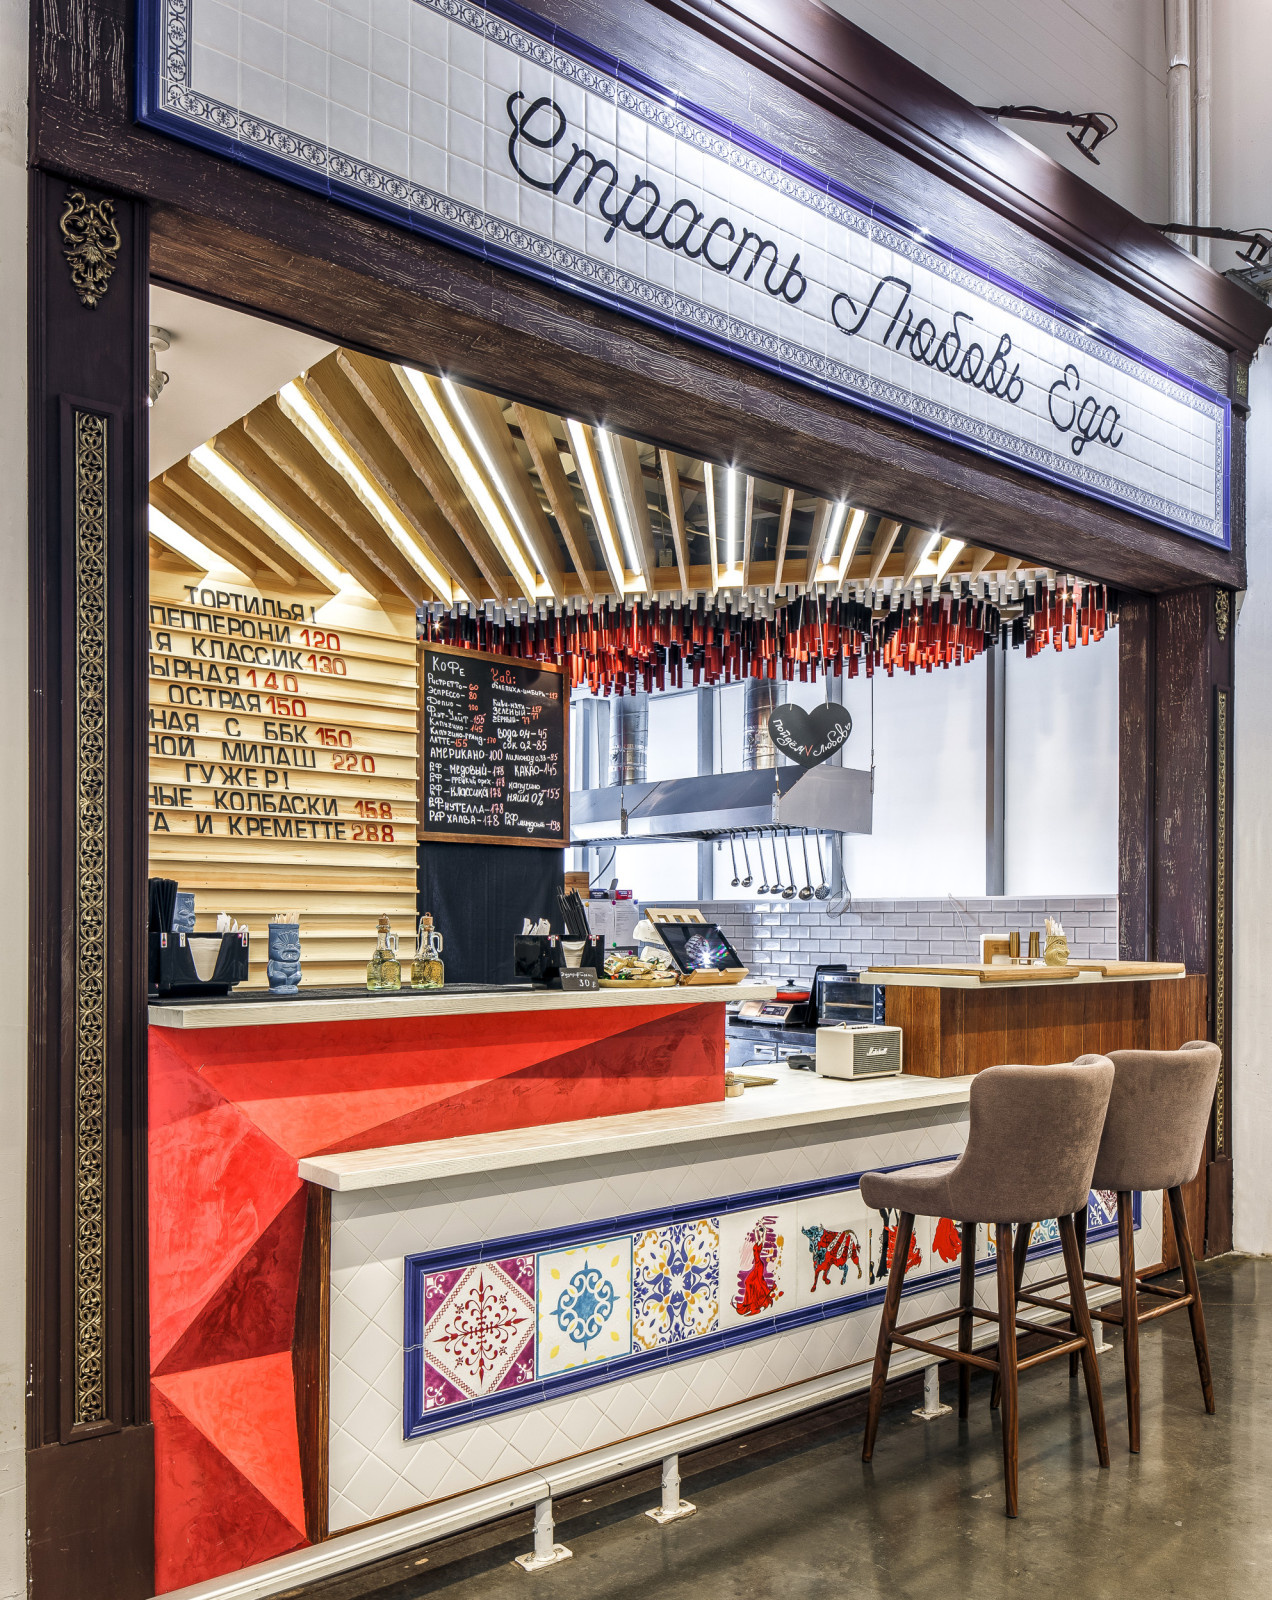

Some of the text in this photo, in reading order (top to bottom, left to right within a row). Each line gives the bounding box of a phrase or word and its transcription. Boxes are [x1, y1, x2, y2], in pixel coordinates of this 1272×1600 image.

[507, 91, 1123, 456] Страсть Любовь Еда
[150, 605, 340, 651] ПЕППЕРОНИ 120
[149, 631, 346, 676] Я КЛАССИК 130
[149, 656, 298, 692] ЫРНАЯ 140
[169, 684, 306, 717] ОСТРАЯ 150
[149, 709, 352, 748] НАЯ С ББК 150
[470, 725, 483, 733] 145
[222, 742, 316, 768] МИЛАШ
[333, 753, 375, 773] 220
[214, 790, 338, 816] КОЛБАСКИ
[354, 800, 392, 820] 158
[196, 814, 213, 834] И
[228, 816, 346, 840] КРЕМЕТТЕ
[352, 823, 394, 842] 288
